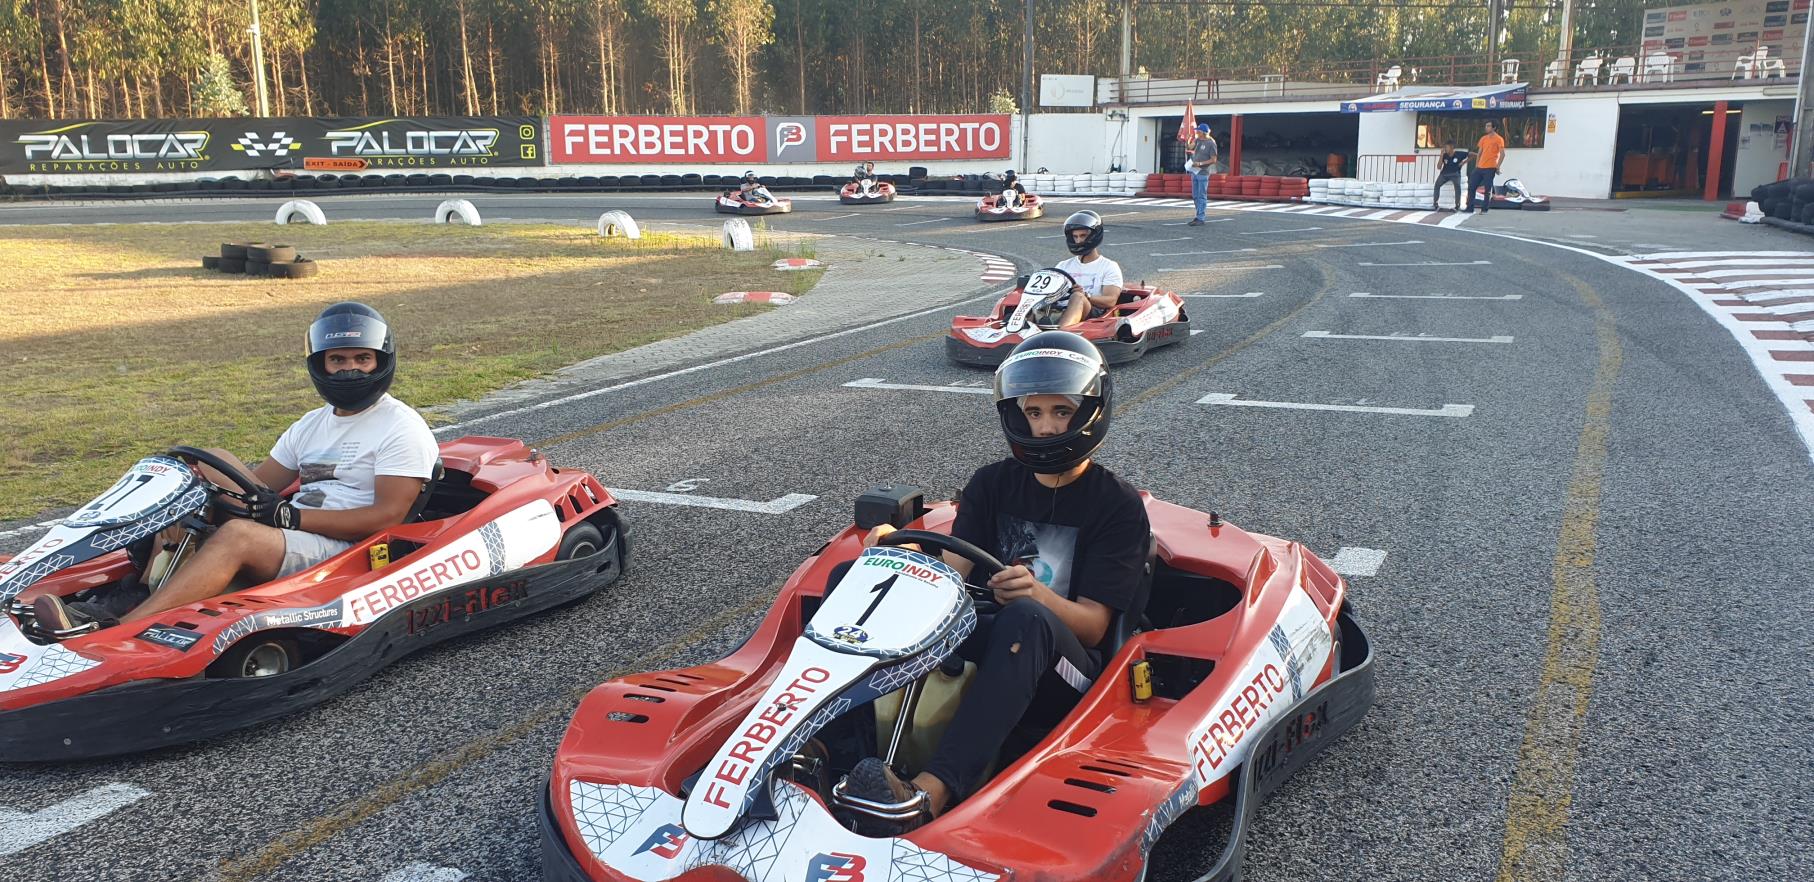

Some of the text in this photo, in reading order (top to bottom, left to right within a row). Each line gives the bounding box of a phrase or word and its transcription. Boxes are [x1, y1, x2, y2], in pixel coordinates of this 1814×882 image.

[1399, 101, 1446, 109] SEGURANÇA
[18, 133, 209, 160] PALOCAR
[325, 131, 499, 156] PALOCAR
[564, 123, 756, 156] FERBERTO
[830, 122, 1000, 154] FERBERTO
[30, 161, 198, 171] REPARAÇÕES AUTO
[450, 157, 489, 165] AUTO
[1030, 275, 1052, 290] 29
[863, 557, 944, 583] EUROINDY
[350, 549, 481, 622] FERBERTO
[855, 573, 900, 626] 1
[265, 608, 338, 626] Metallic Structures
[1193, 663, 1284, 783] FERBERTO
[703, 667, 831, 809] FERBERTO
